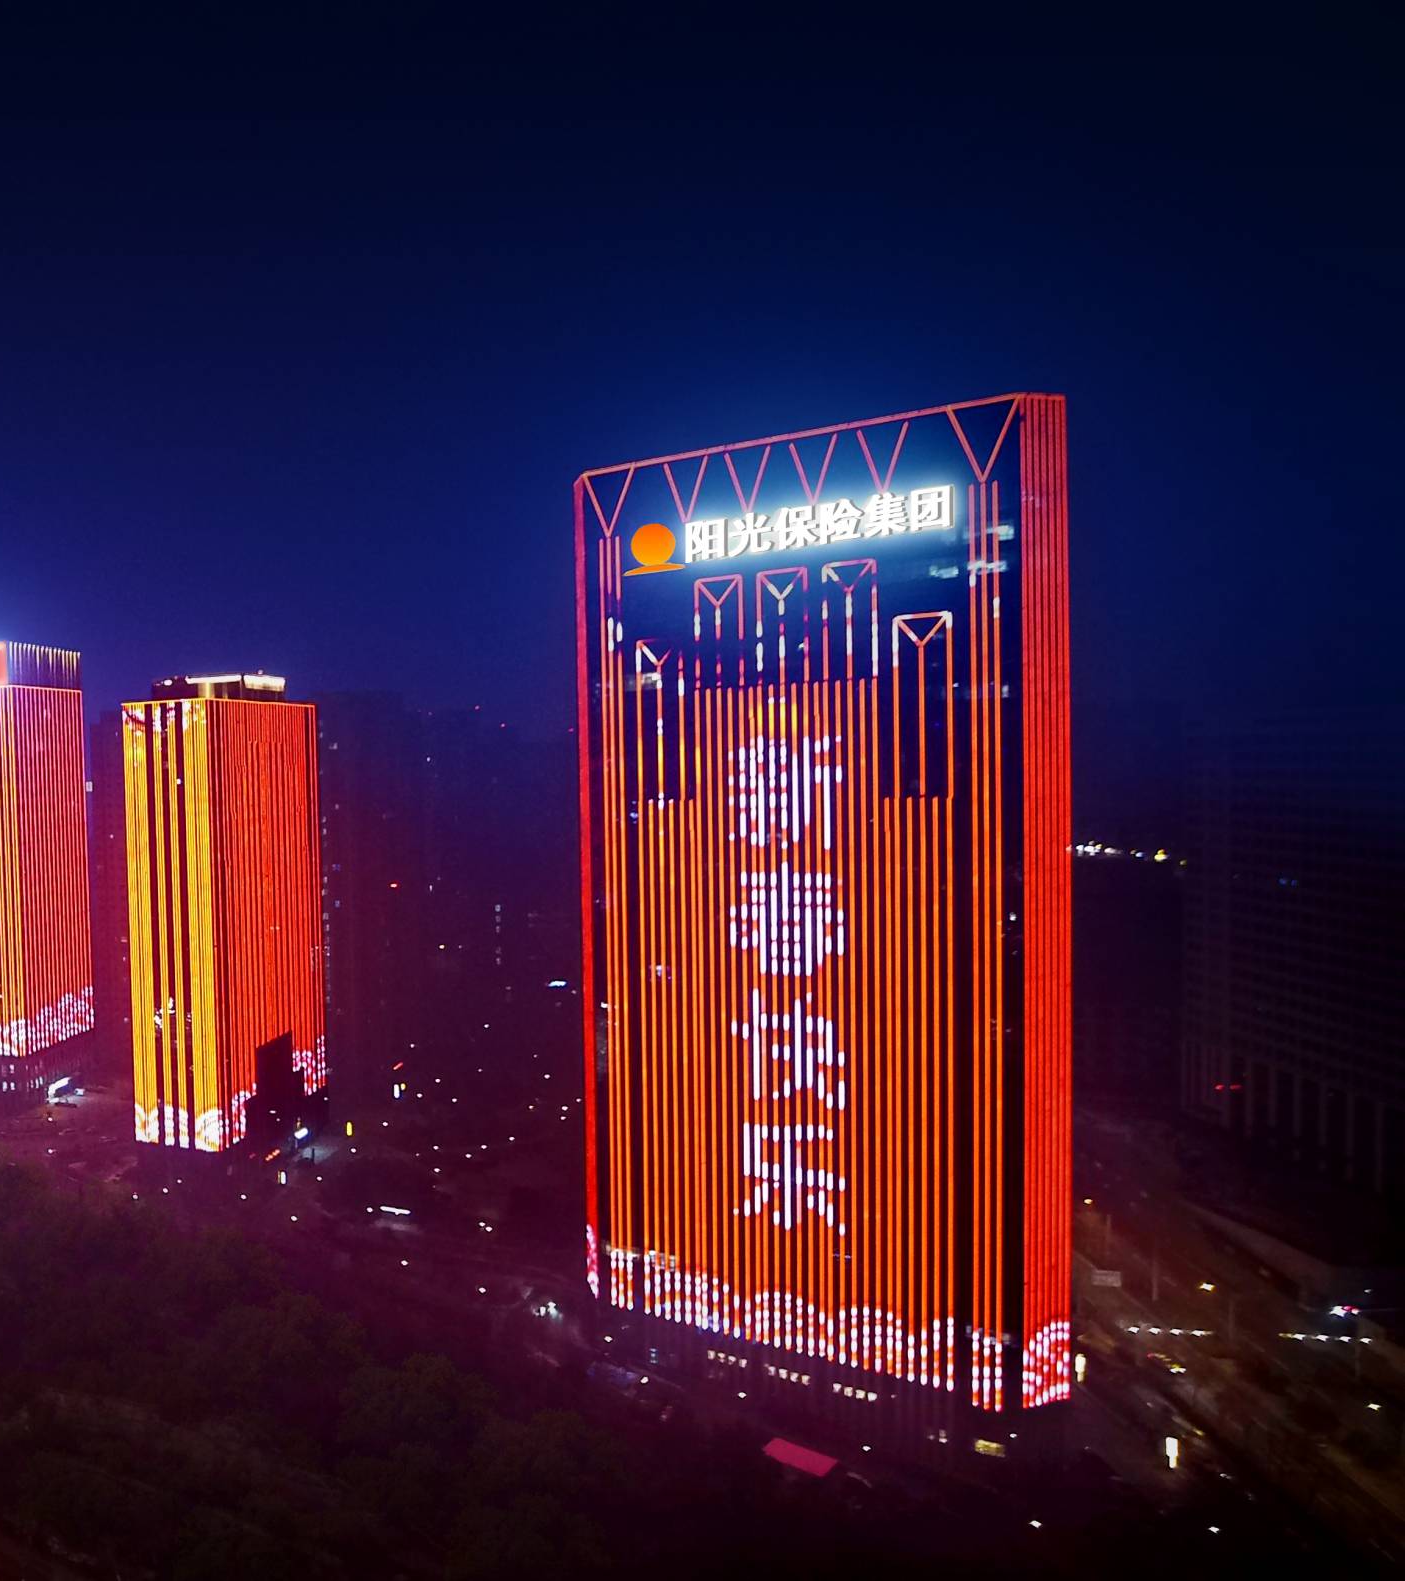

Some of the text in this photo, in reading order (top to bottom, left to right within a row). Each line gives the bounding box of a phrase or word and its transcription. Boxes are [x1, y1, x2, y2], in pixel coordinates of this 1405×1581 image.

[684, 484, 955, 564] 阳光保险集团
[726, 734, 846, 1236] 新春快乐
